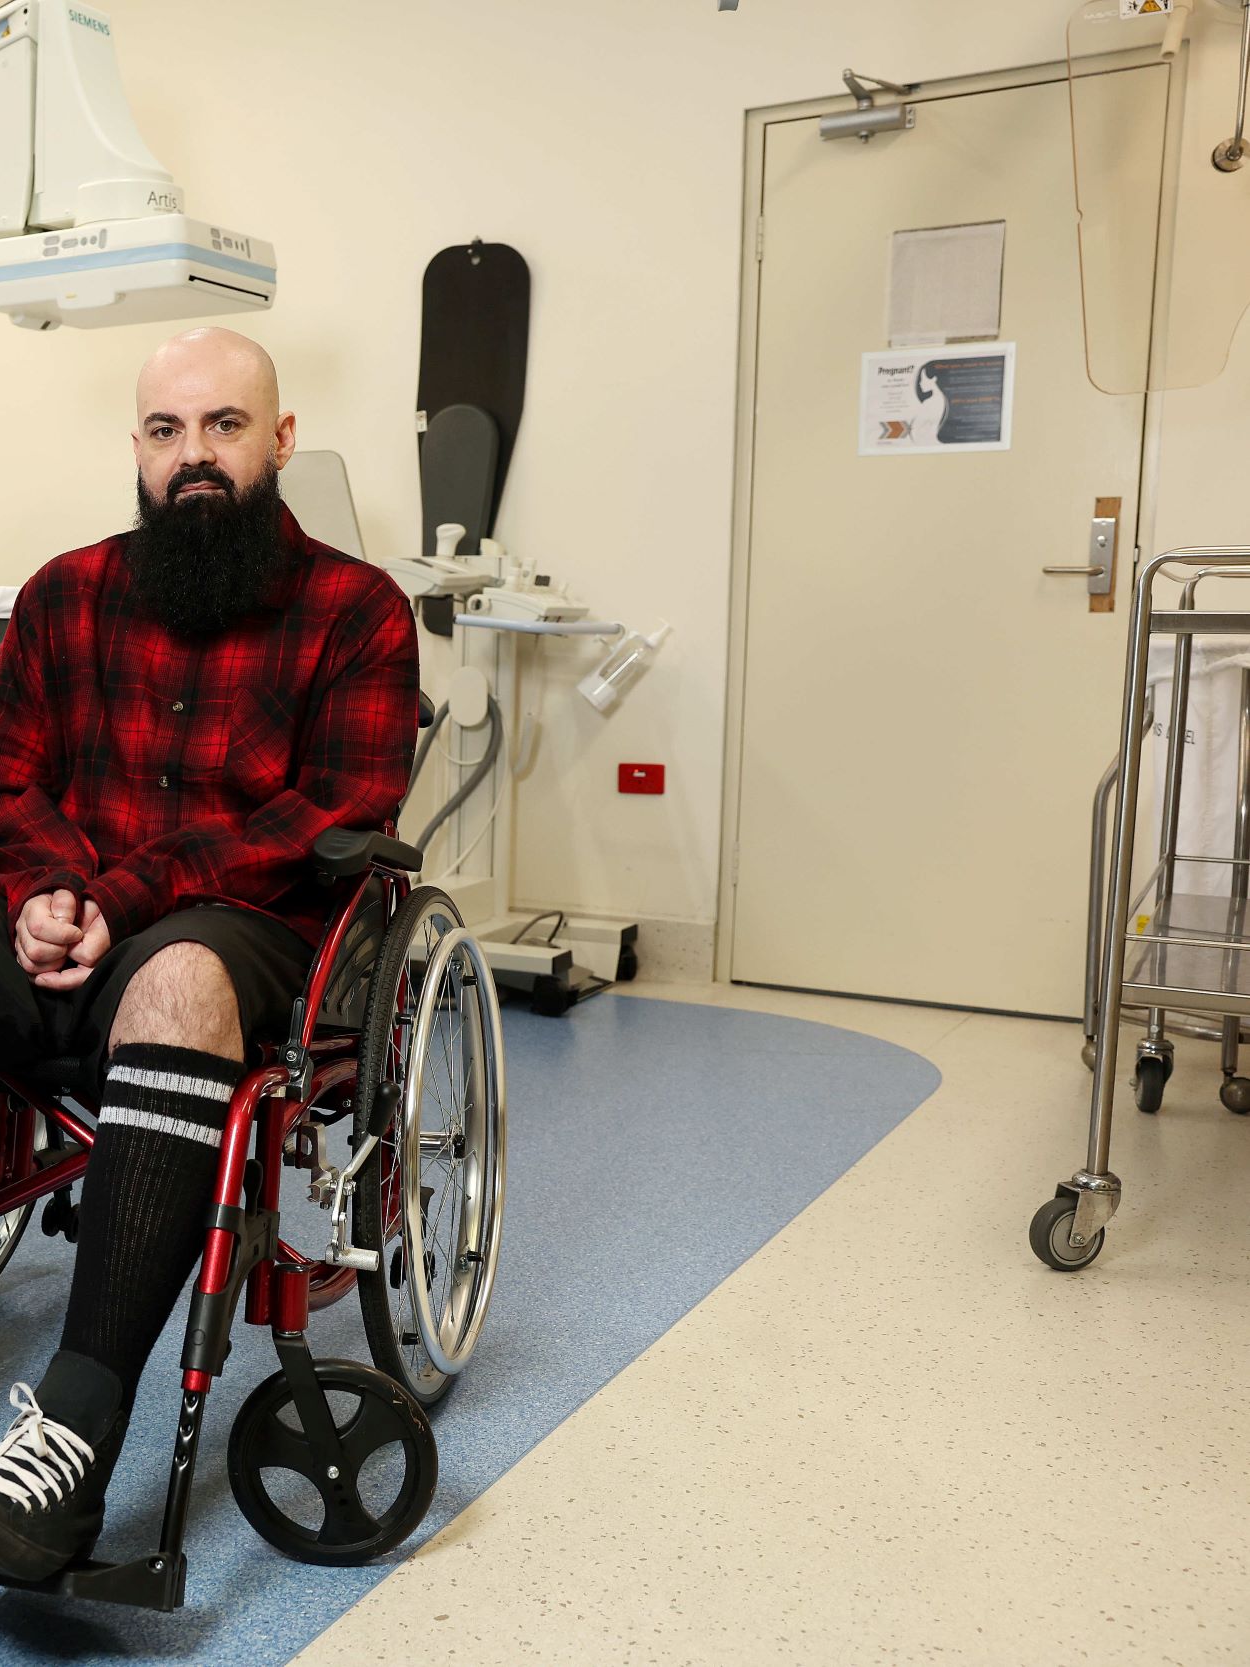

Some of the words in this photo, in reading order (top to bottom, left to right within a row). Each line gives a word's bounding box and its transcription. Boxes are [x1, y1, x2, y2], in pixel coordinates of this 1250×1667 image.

[68, 9, 110, 36] SIEMENS
[147, 191, 178, 209] Artis
[877, 364, 914, 376] Pregnant?
